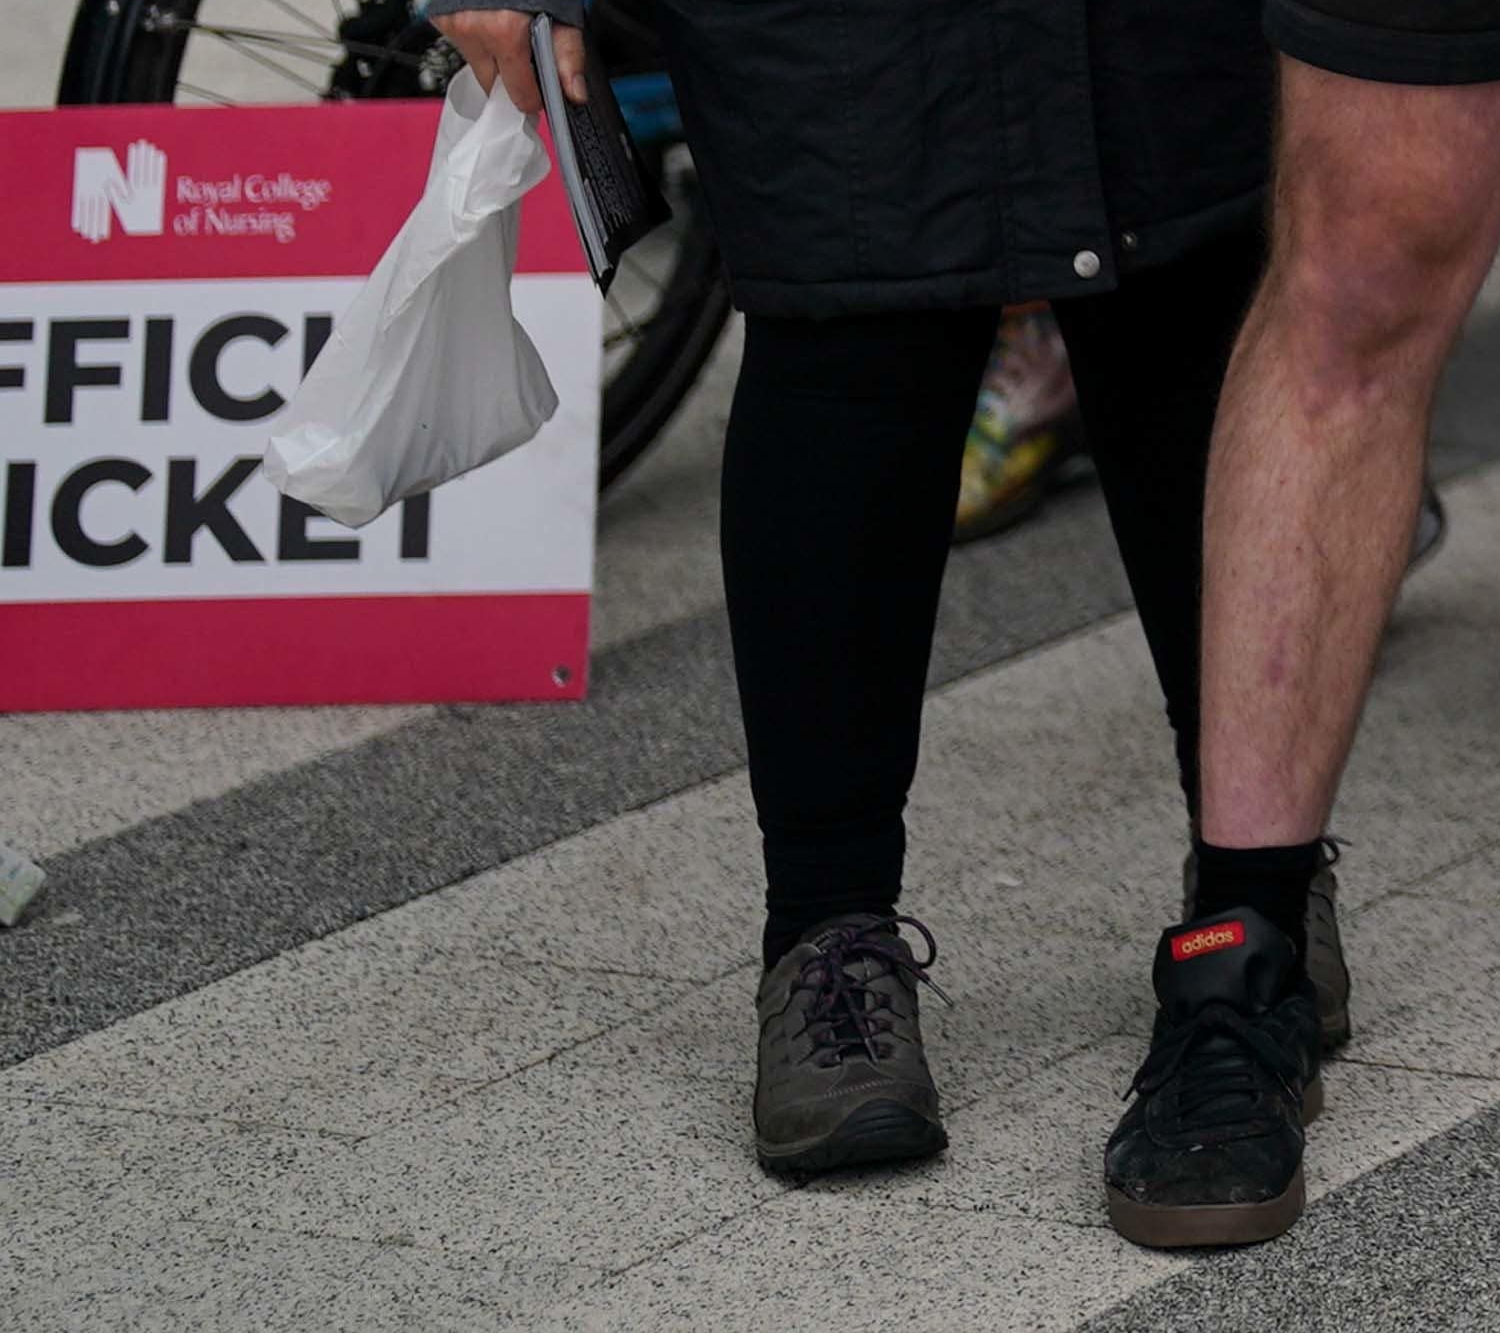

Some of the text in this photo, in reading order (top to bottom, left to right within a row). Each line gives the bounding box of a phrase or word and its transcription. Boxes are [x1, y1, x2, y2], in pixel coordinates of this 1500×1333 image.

[175, 172, 333, 211] Royal College
[173, 205, 297, 245] of Nursing
[1181, 930, 1235, 954] adidas
